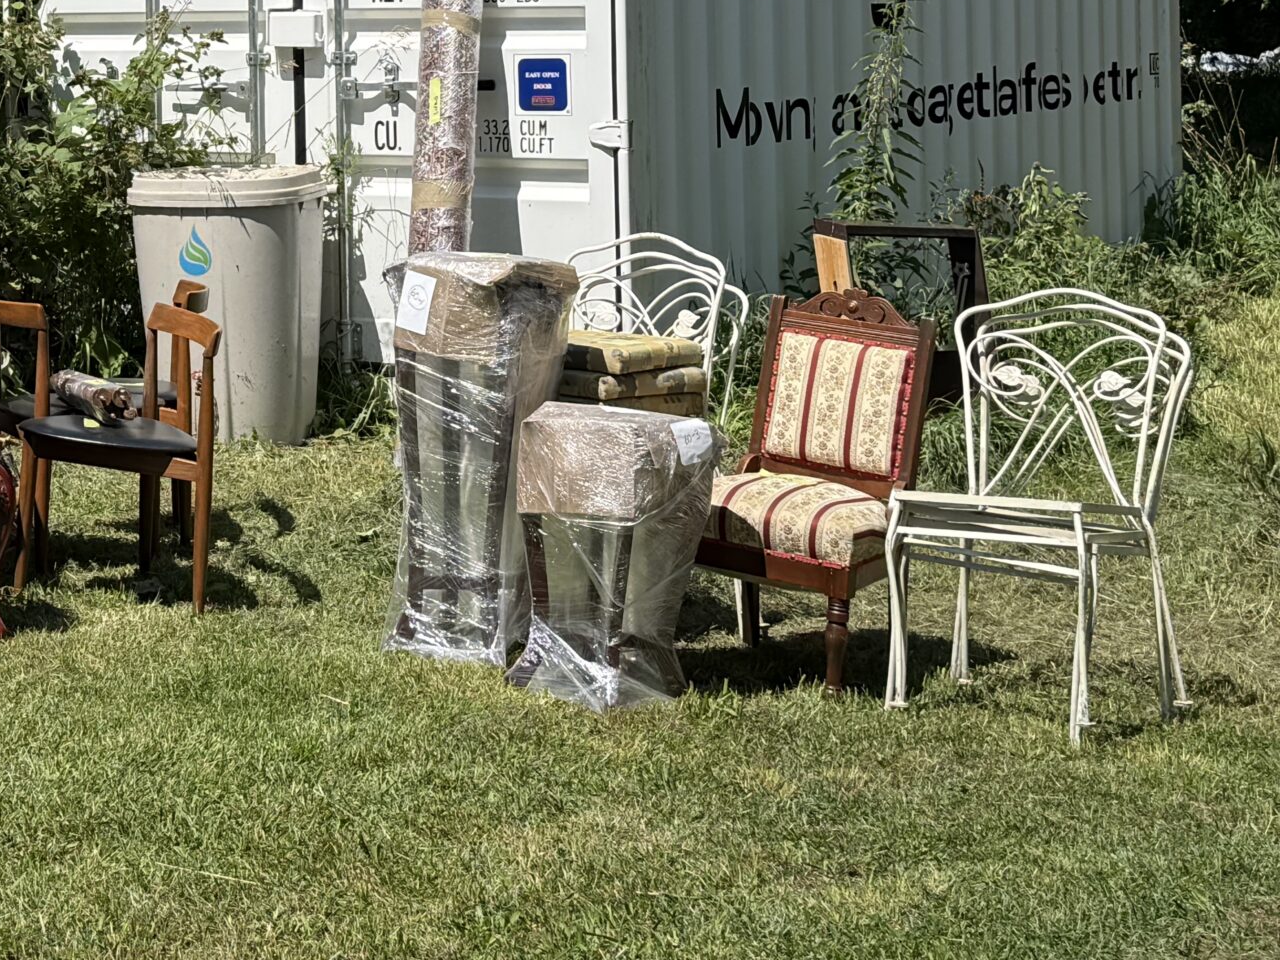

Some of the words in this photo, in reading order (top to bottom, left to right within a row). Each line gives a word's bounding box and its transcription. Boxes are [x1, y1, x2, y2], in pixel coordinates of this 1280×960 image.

[525, 71, 540, 79] EASY
[542, 71, 559, 79] OPEN
[374, 120, 402, 151] CU.
[483, 119, 509, 136] 33.2
[520, 119, 548, 136] CU.M
[479, 136, 509, 153] 1.170
[520, 137, 554, 154] CU.FT
